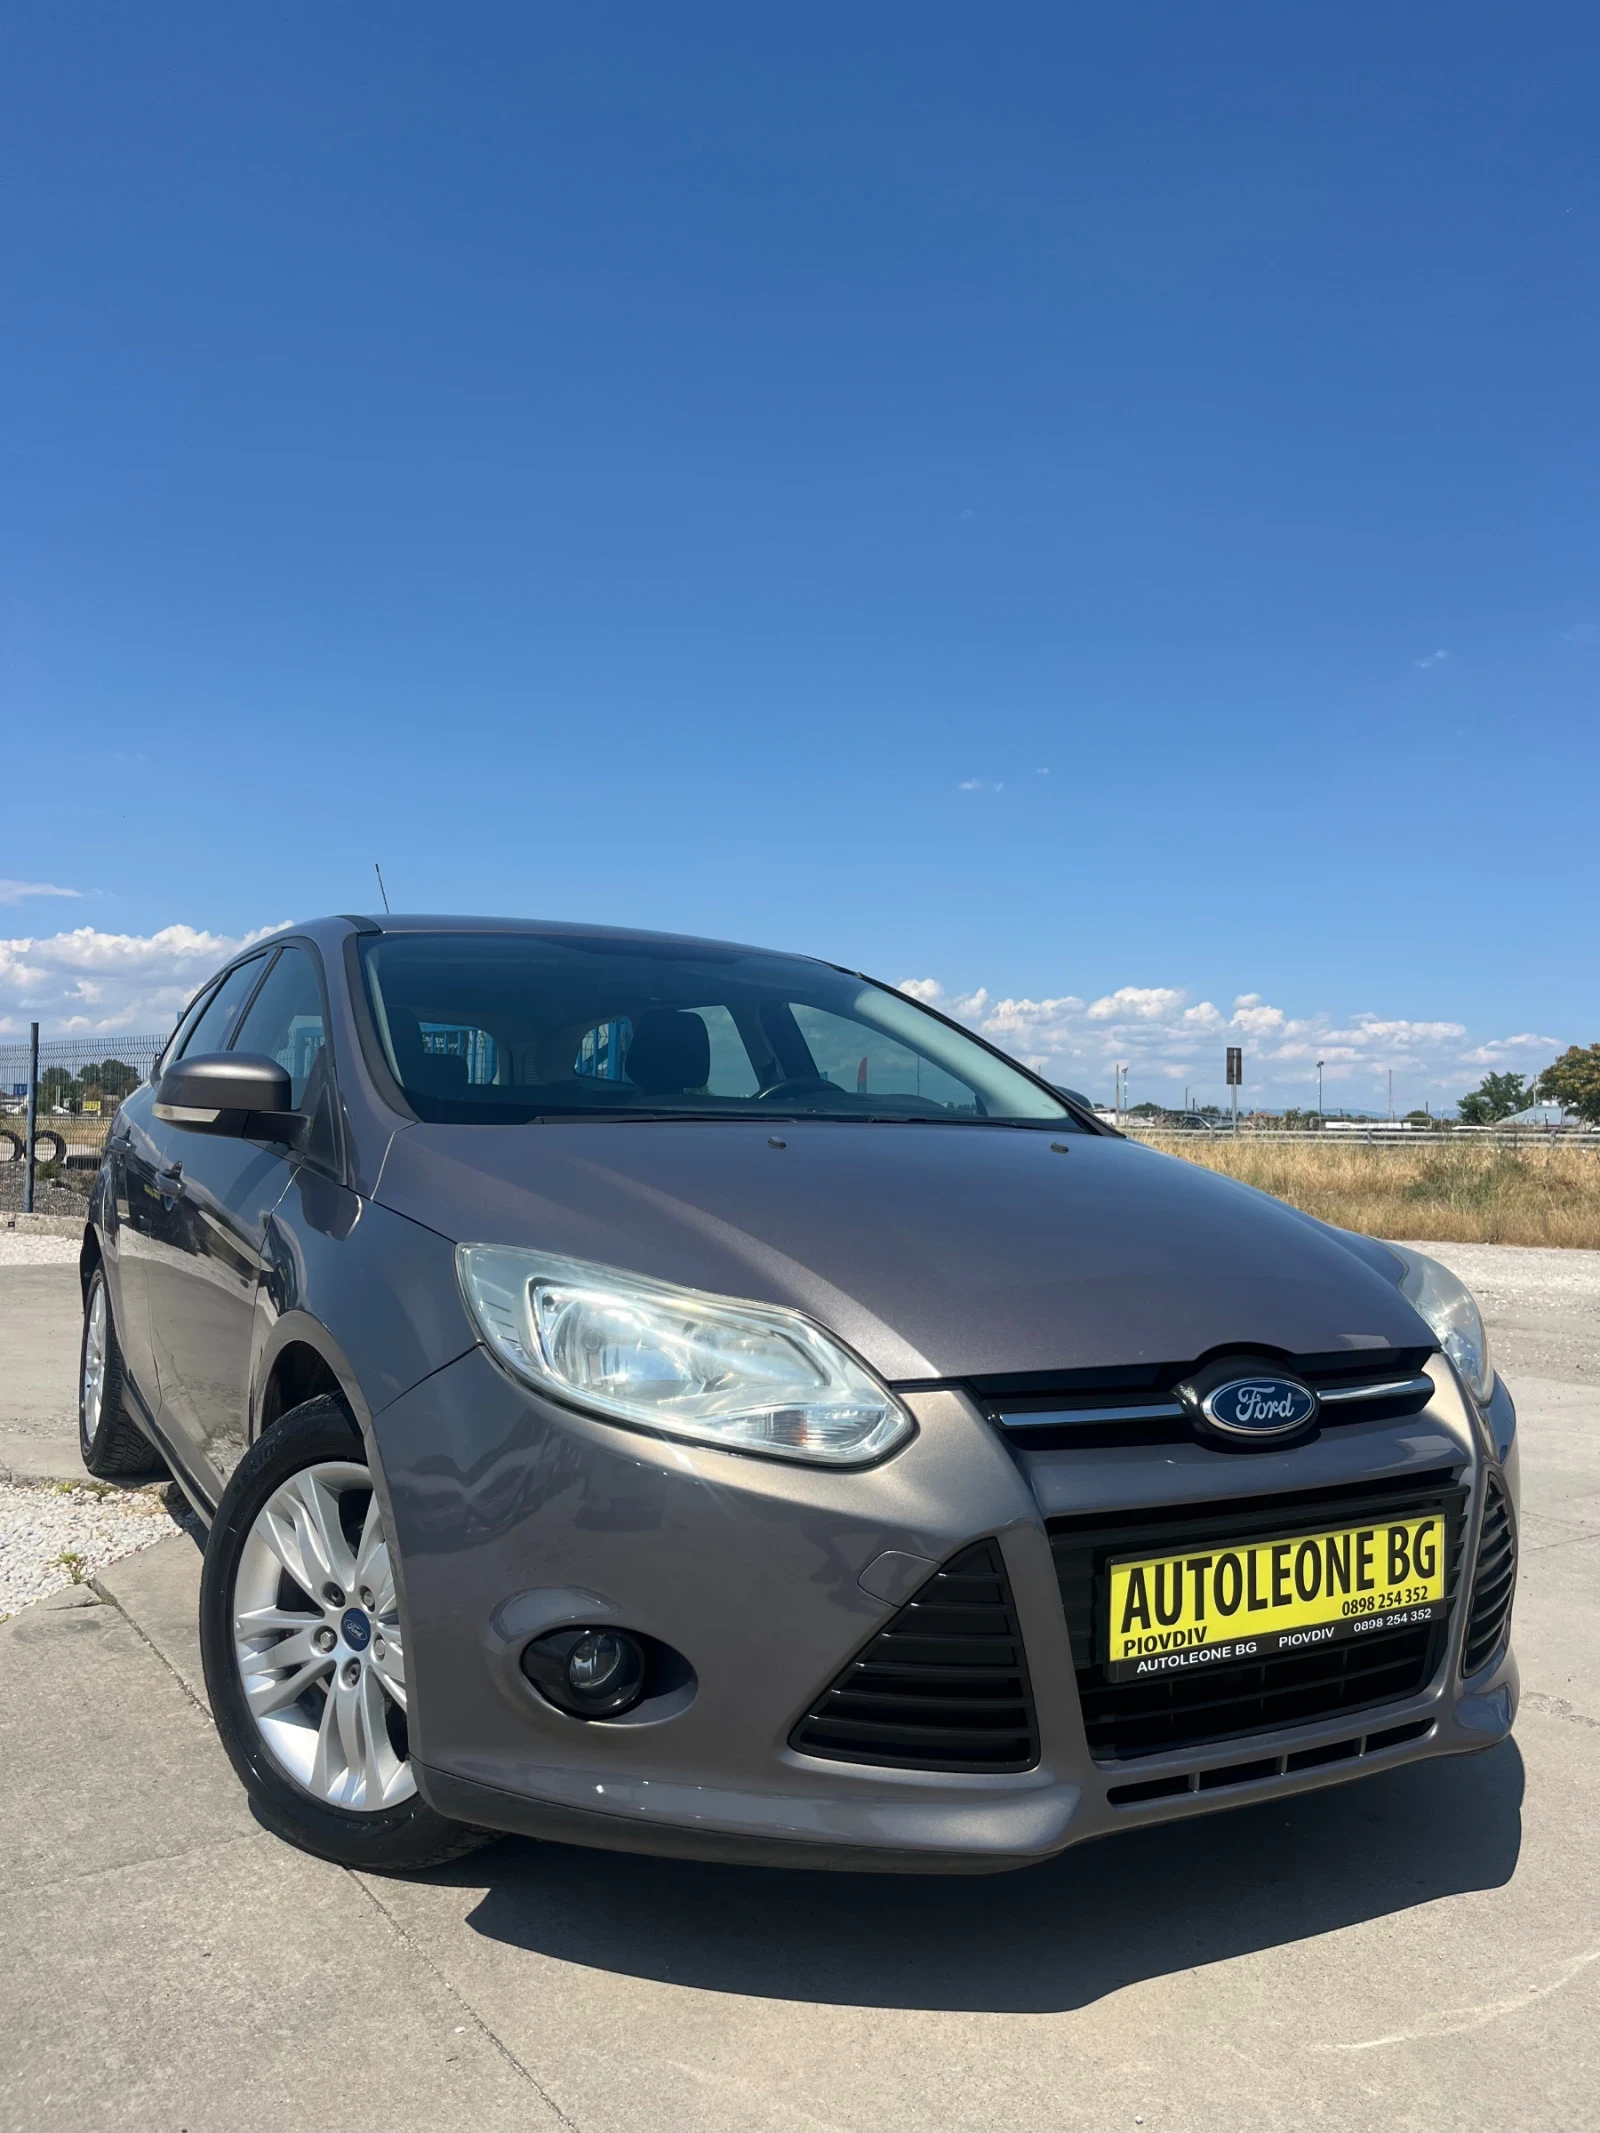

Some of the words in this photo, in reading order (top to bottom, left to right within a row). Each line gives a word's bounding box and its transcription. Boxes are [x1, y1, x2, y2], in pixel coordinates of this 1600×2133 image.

[1236, 1386, 1294, 1421] Ford
[1120, 1530, 1375, 1634] AUTOLEONE
[1387, 1520, 1436, 1586] BG
[1342, 1596, 1375, 1616] 0898
[1378, 1591, 1403, 1609] 254
[1405, 1586, 1428, 1604] 352
[347, 1623, 363, 1637] Ford
[1123, 1626, 1208, 1657] PIOVDIV
[1136, 1646, 1232, 1673] AUTOLEONE
[1235, 1641, 1257, 1655] BG
[1278, 1627, 1335, 1647] PIOVDIV
[1353, 1618, 1383, 1632] 0898
[1386, 1613, 1408, 1626] 254
[1410, 1608, 1432, 1621] 352
